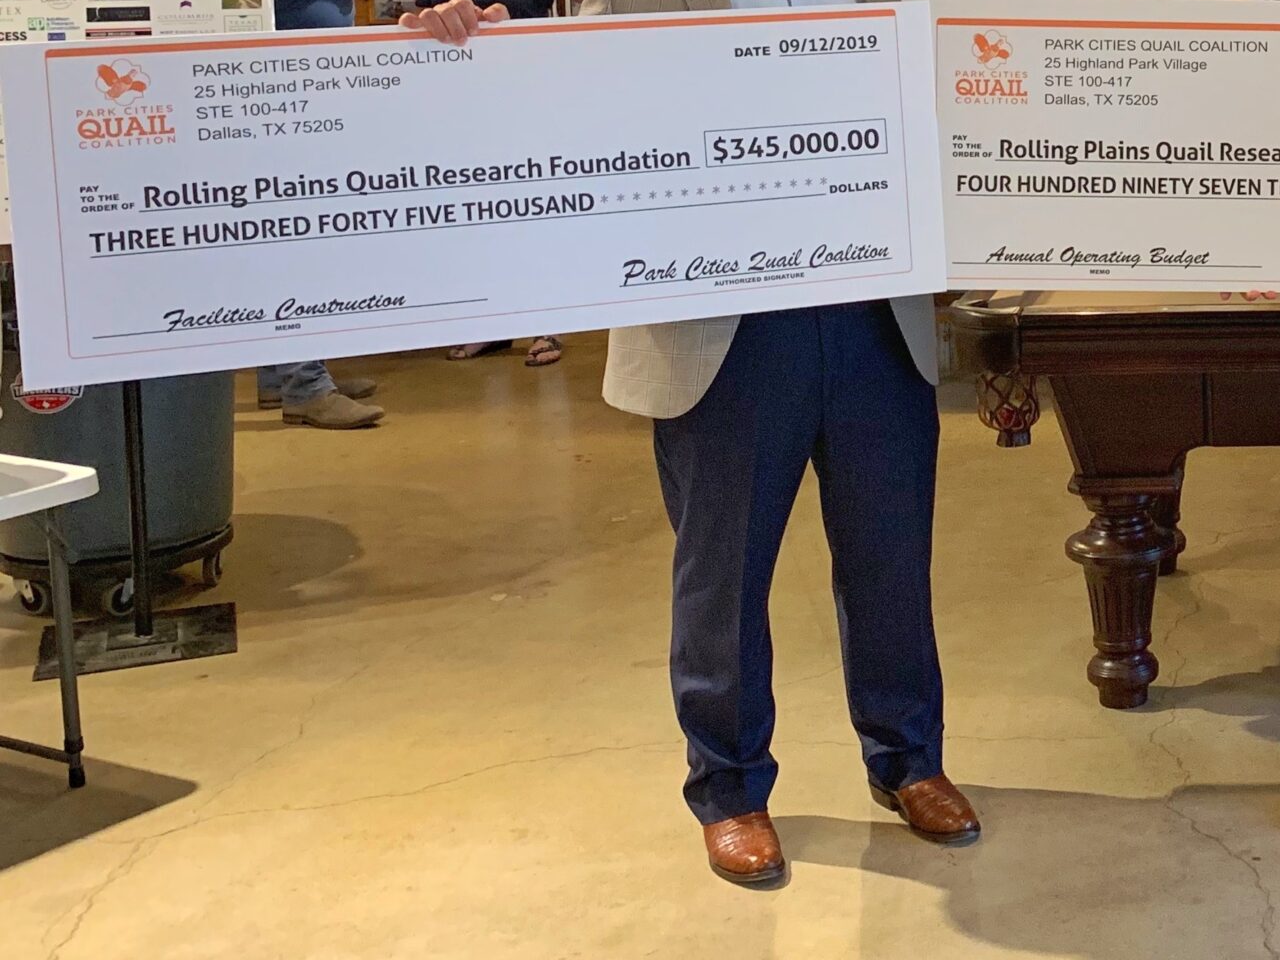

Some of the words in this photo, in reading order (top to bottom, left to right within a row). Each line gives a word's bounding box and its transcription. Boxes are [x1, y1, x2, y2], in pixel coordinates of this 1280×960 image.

[734, 46, 771, 58] DATE
[778, 35, 878, 55] 09/12/2019
[1044, 39, 1084, 51] PARK
[1089, 39, 1136, 52] CITIES
[1140, 39, 1184, 52] QUAIL
[1189, 40, 1268, 53] COALITION
[193, 60, 243, 77] PARK
[250, 57, 310, 74] CITIES
[316, 55, 371, 71] QUAIL
[377, 48, 473, 67] COALITION
[1044, 58, 1061, 70] 25
[1065, 57, 1124, 71] Highland
[1129, 58, 1159, 70] Park
[1163, 58, 1207, 73] Village
[194, 83, 216, 99] 25
[222, 78, 297, 98] Highland
[303, 76, 341, 91] Park
[346, 72, 401, 91] Village
[955, 79, 1028, 97] QUAIL
[1044, 75, 1073, 87] STE
[1079, 75, 1133, 88] 100-417
[196, 104, 234, 120] STE
[241, 100, 309, 117] 100-417
[1044, 93, 1090, 107] Dallas,
[1094, 94, 1113, 105] TX
[1117, 94, 1158, 106] 75205
[77, 115, 175, 141] QUAIL
[198, 123, 257, 141] Dallas,
[262, 121, 288, 136] TX
[293, 118, 344, 134] 75205
[79, 135, 177, 150] COALITION
[712, 128, 880, 164] $345,000.00
[1000, 139, 1078, 164] Rolling
[1084, 140, 1150, 161] Plains
[1156, 141, 1214, 164] Quail
[144, 184, 248, 208] Rolling
[255, 175, 339, 200] Plains
[346, 167, 419, 196] Quail
[425, 158, 543, 186] Research
[550, 148, 691, 176] Foundation
[829, 181, 888, 195] DOLLARS
[956, 175, 1011, 192] FOUR
[1017, 176, 1116, 194] HUNDRED
[1122, 177, 1194, 195] NINETY
[1199, 179, 1262, 196] SEVEN
[90, 228, 175, 253] THREE
[183, 217, 311, 246] HUNDRED
[318, 209, 398, 234] FORTY
[405, 204, 457, 226] FIVE
[462, 193, 595, 221] THOUSAND
[621, 259, 678, 286] Park
[684, 257, 740, 280] Cities
[748, 249, 803, 273] Quail
[809, 243, 889, 267] Coalition
[986, 245, 1055, 263] Annual
[1059, 246, 1142, 268] Operating
[1149, 247, 1210, 268] Budget
[163, 307, 267, 332] Facilities
[274, 293, 407, 321] Construction
